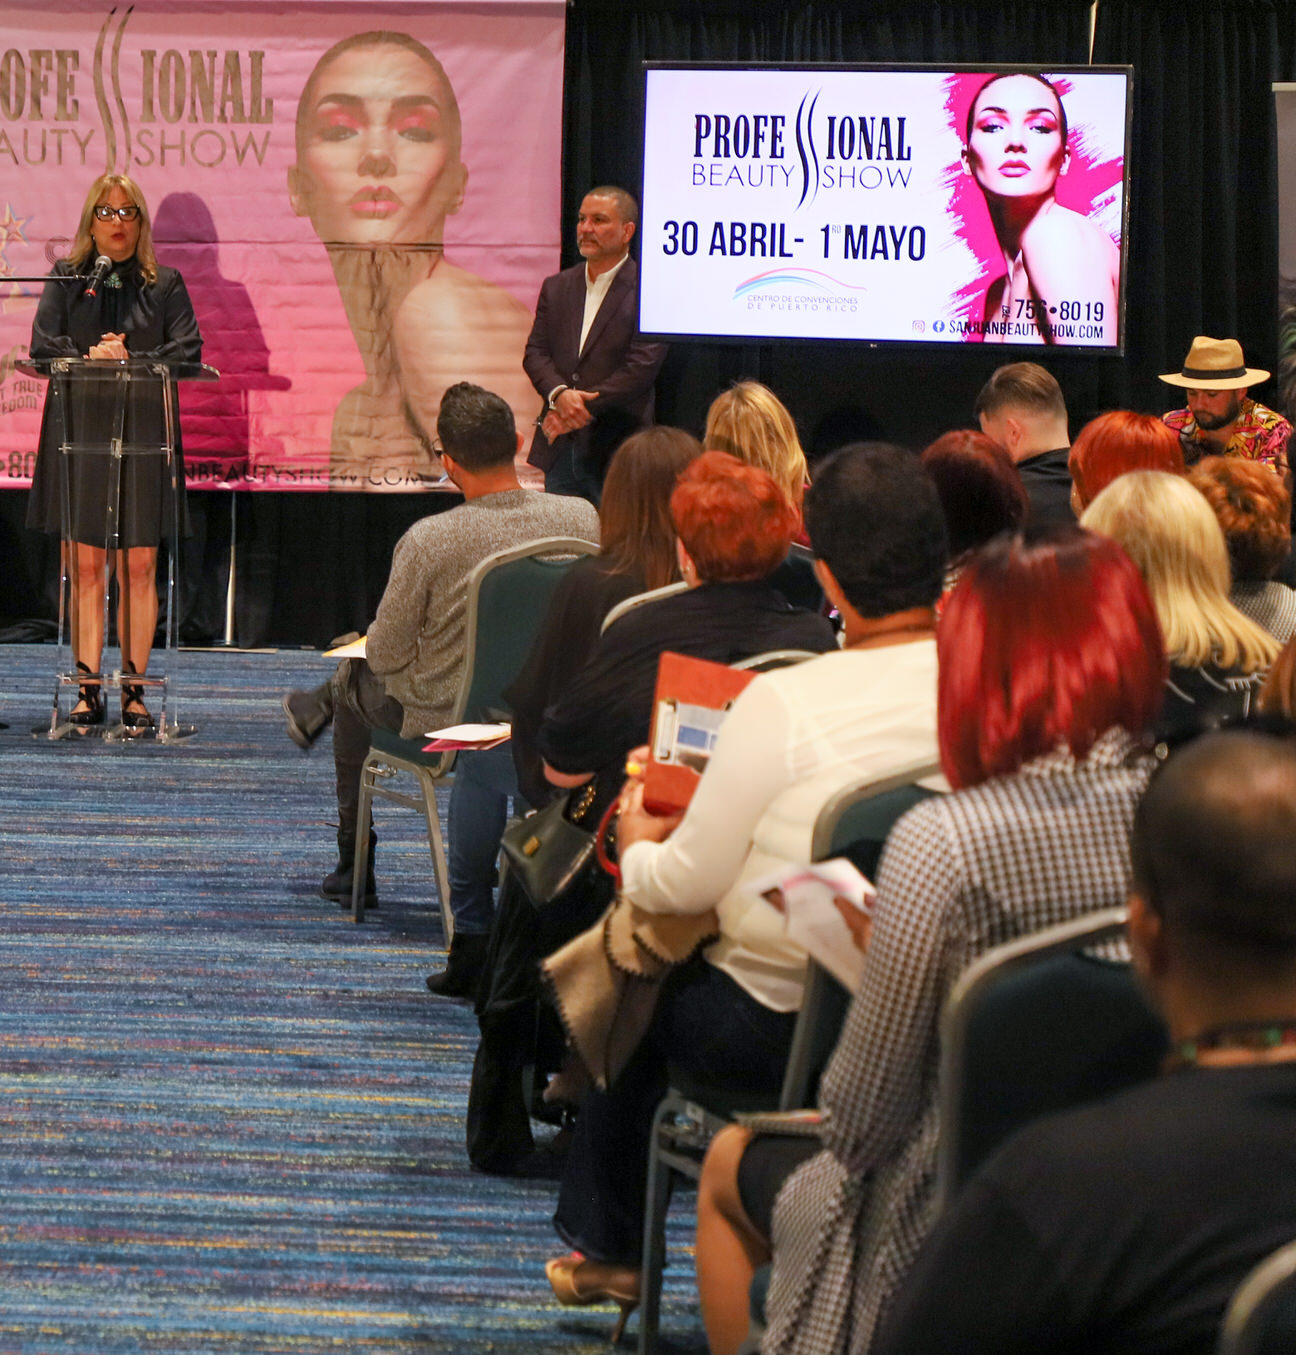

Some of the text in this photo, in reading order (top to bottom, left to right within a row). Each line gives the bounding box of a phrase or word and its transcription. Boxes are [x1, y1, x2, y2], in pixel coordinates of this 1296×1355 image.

[135, 129, 271, 167] SHOW
[692, 163, 913, 190] BEAUTY SHOW
[662, 220, 699, 256] 30
[708, 221, 805, 258] ABRIL-
[843, 224, 926, 261] MAYO
[747, 294, 858, 304] CENTRO DE CONVENCIONES
[770, 303, 819, 312] PUERTO
[826, 304, 858, 313] RICO
[12, 380, 43, 398] TRUE
